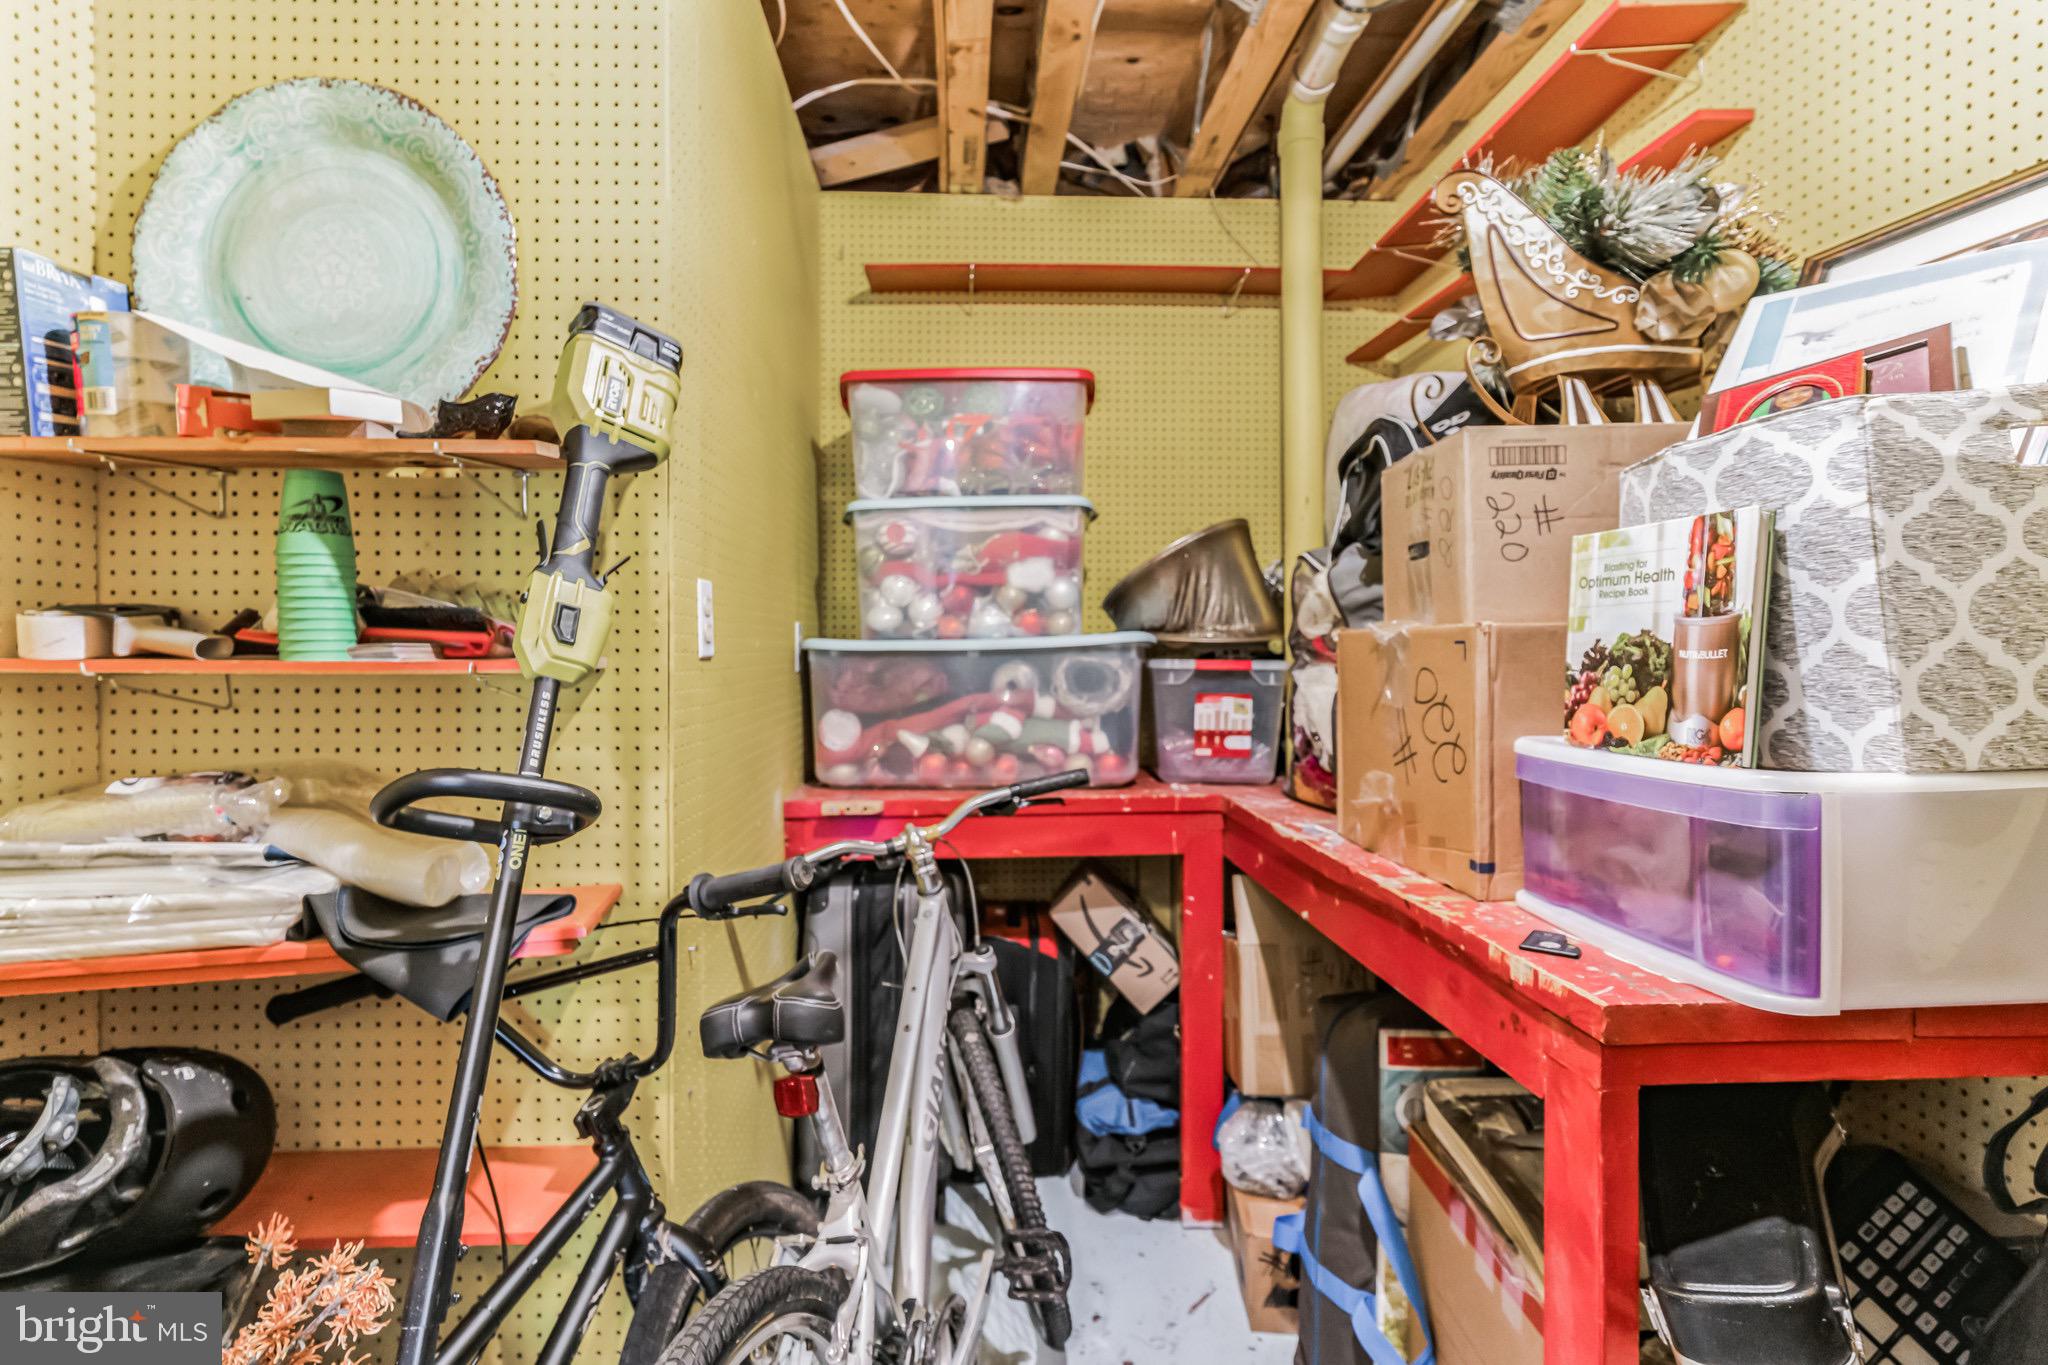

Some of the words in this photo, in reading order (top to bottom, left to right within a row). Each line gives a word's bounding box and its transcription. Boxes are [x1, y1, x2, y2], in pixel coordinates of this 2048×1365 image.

[1533, 494, 1565, 536] #
[1578, 575, 1631, 590] Optimum
[1634, 567, 1675, 584] Health
[1604, 561, 1635, 573] Blasting
[1636, 559, 1648, 569] for
[1599, 588, 1626, 599] Recipe
[1628, 586, 1649, 597] Book
[530, 690, 551, 767] BRUSHLESS
[1392, 704, 1417, 786] #
[508, 828, 528, 870] ONE
